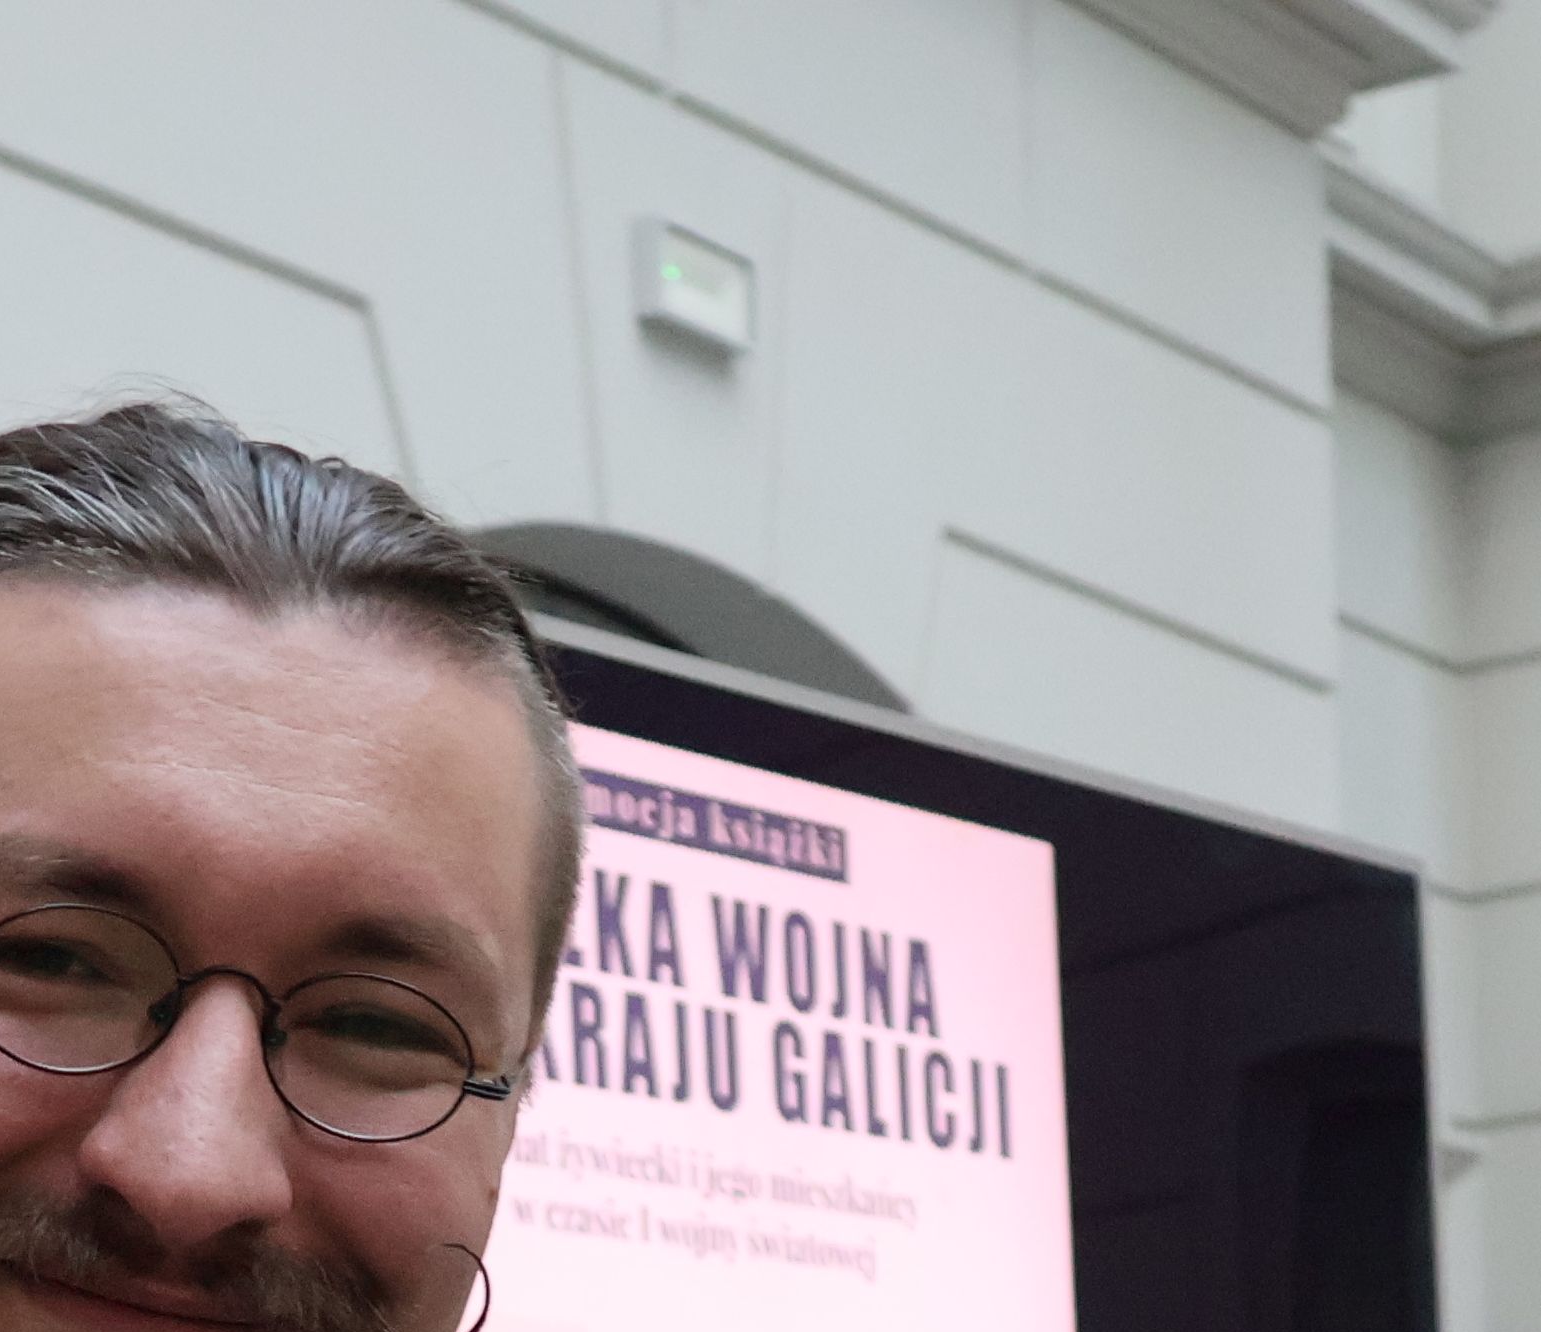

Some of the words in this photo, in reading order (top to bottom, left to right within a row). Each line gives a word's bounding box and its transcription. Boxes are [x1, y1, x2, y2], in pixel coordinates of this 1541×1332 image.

[563, 868, 685, 988] KA
[711, 892, 940, 1039] WOJNA
[772, 1020, 1014, 1159] GALICJI
